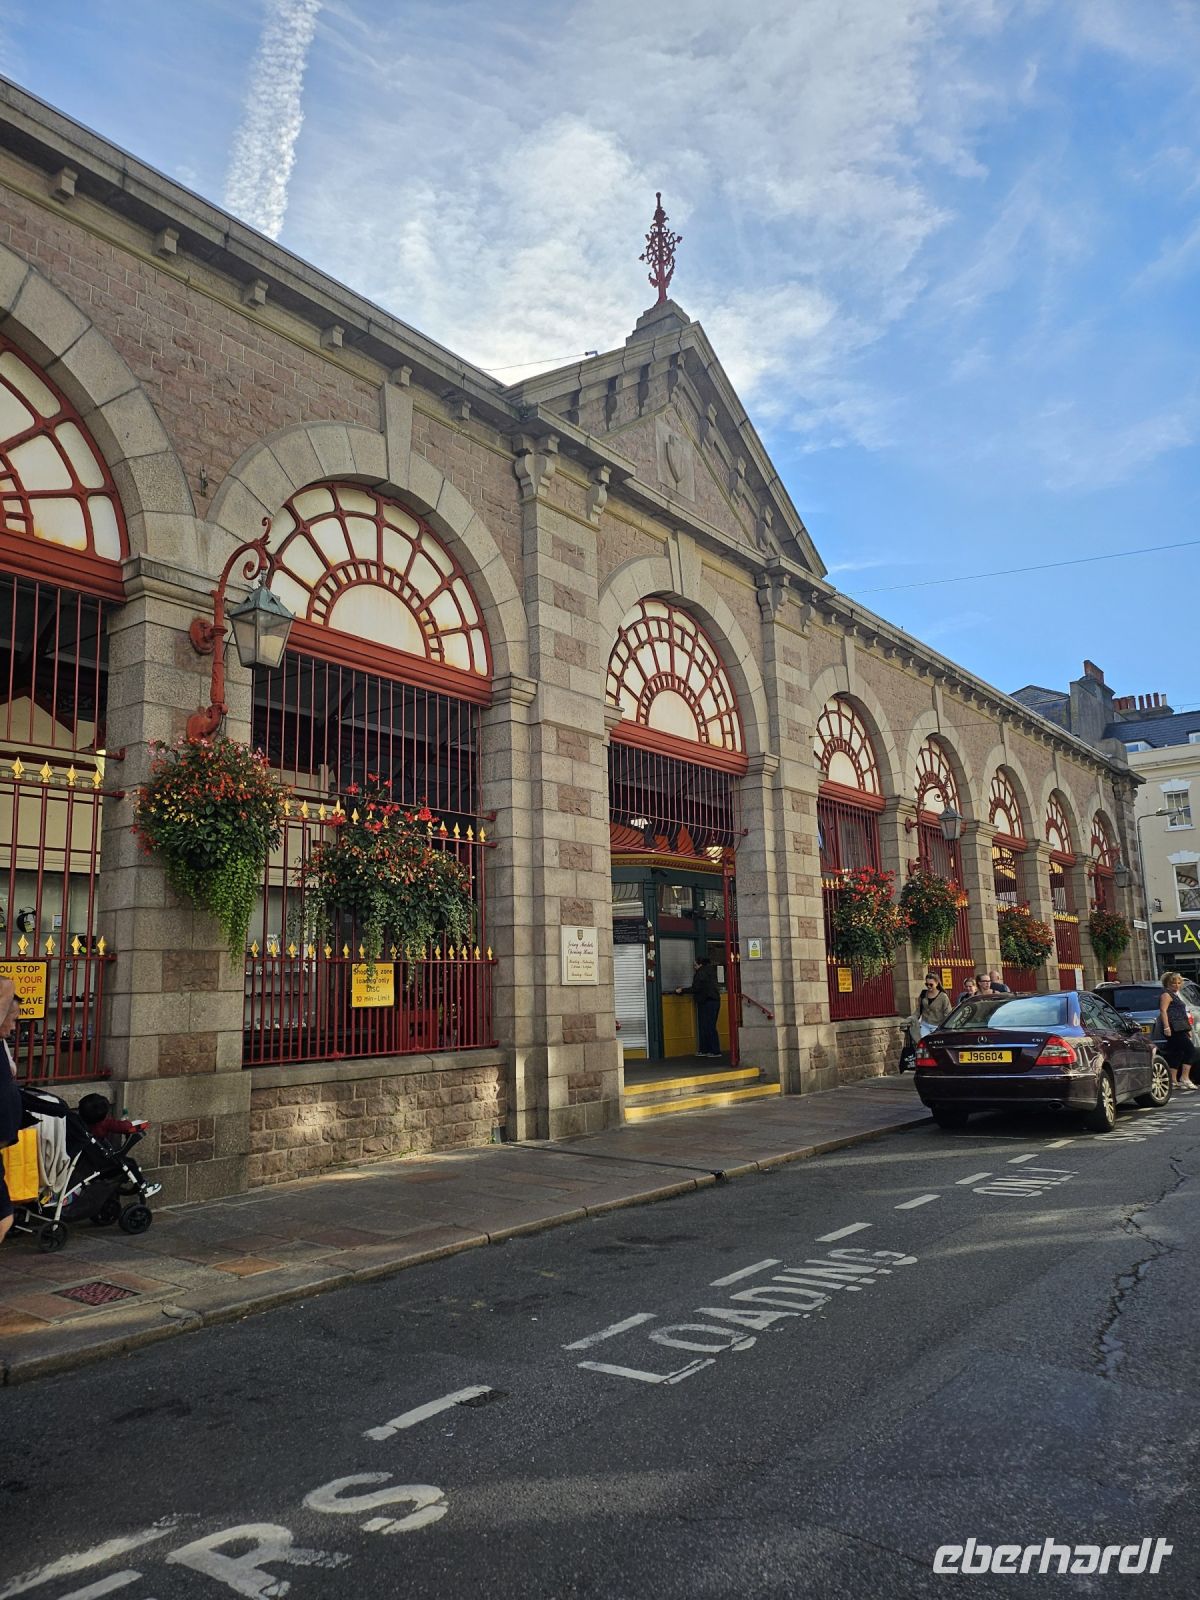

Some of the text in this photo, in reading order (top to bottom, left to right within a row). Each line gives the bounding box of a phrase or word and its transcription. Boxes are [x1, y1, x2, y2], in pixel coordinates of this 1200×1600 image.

[1154, 924, 1200, 950] CHA
[20, 997, 44, 1005] EAVE
[967, 1051, 1003, 1062] J96604
[972, 1166, 1080, 1198] ONLY
[577, 1248, 918, 1385] LOADING
